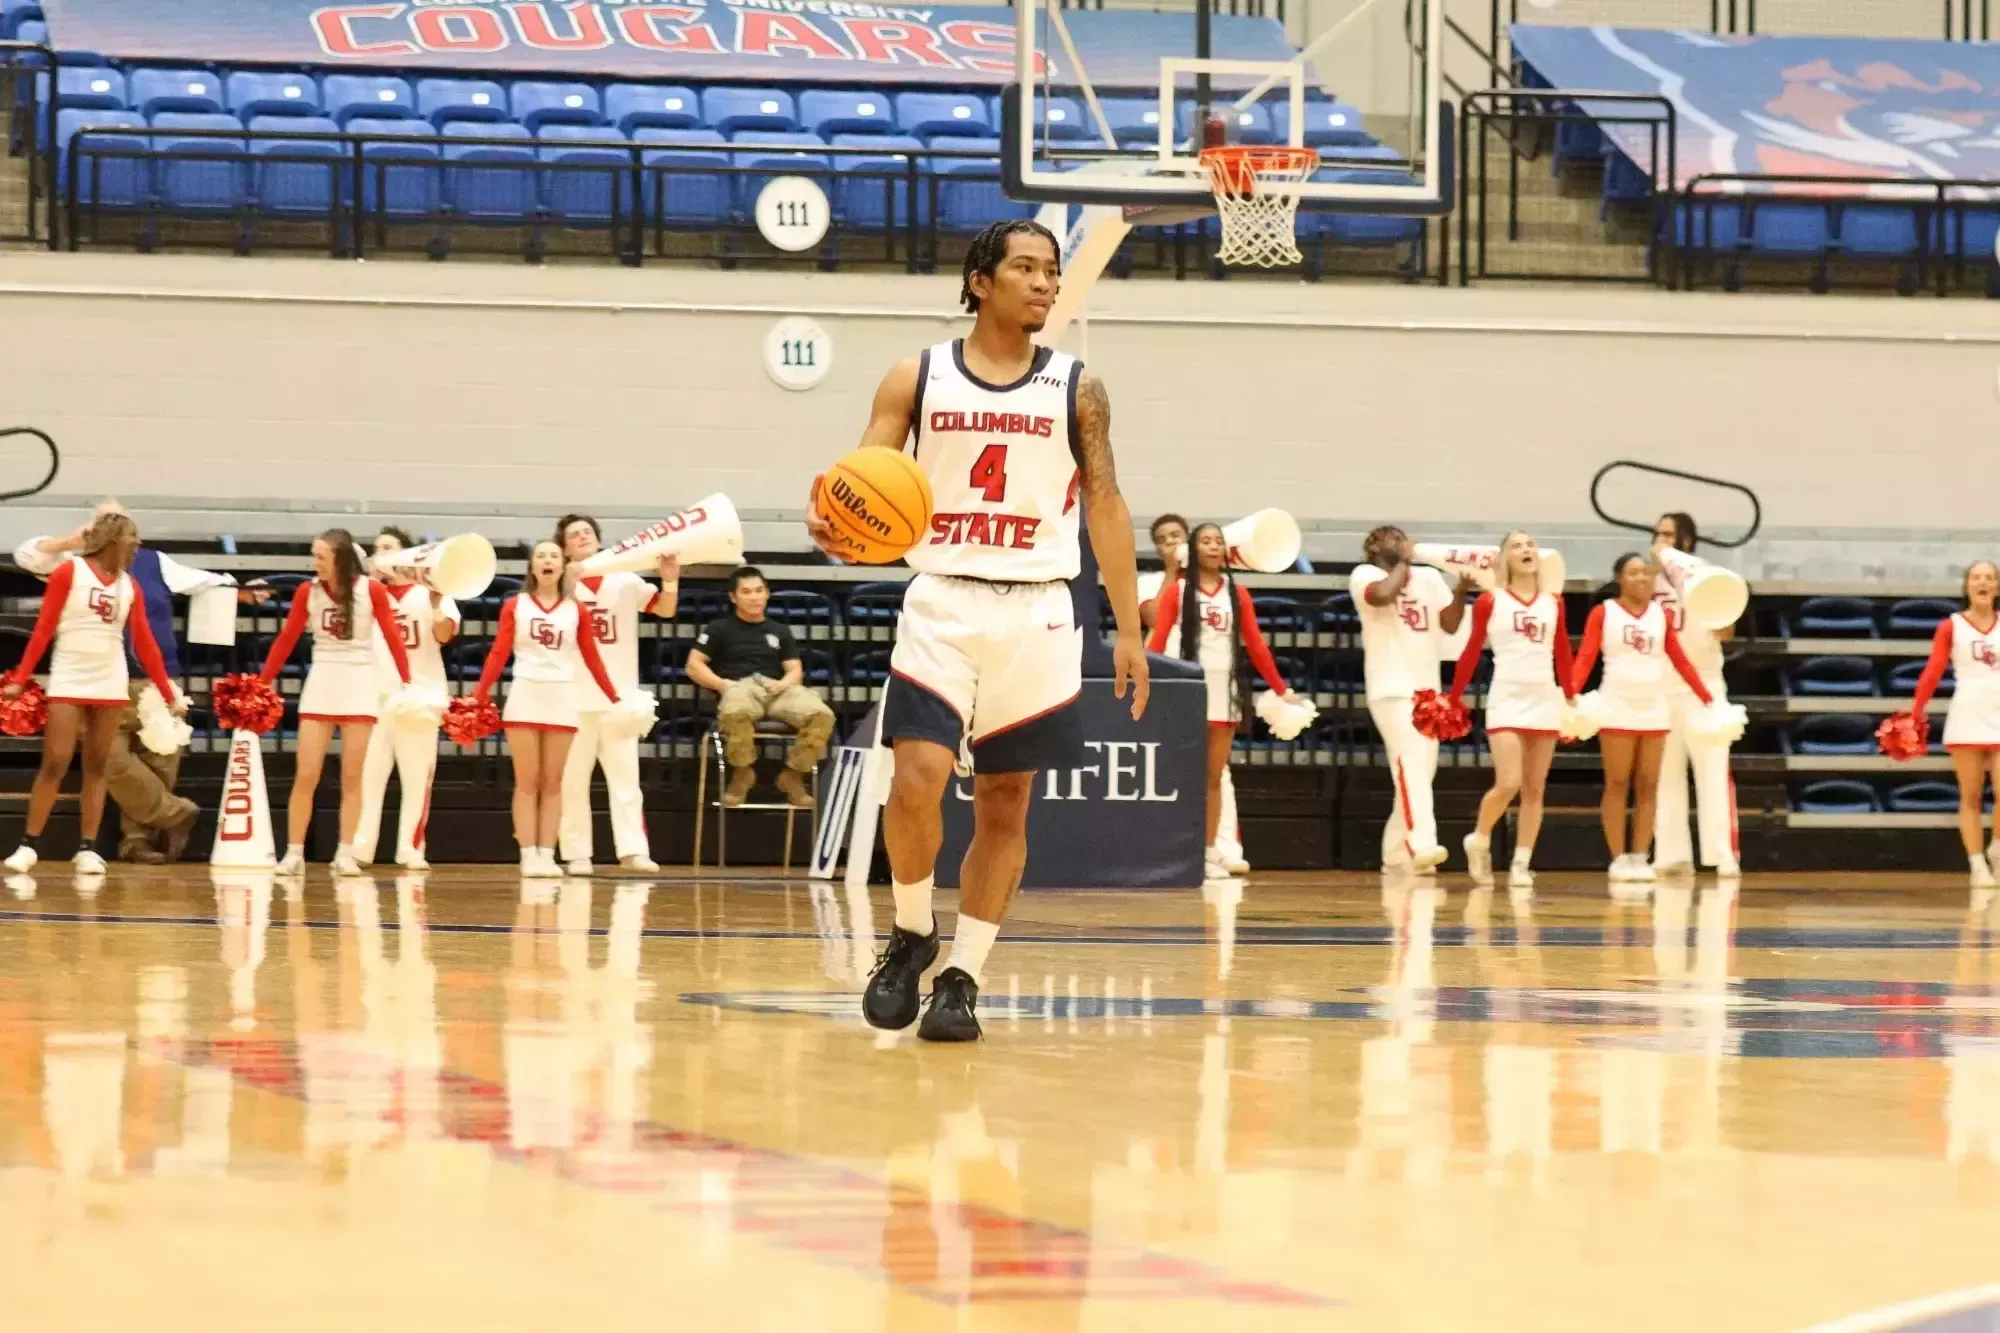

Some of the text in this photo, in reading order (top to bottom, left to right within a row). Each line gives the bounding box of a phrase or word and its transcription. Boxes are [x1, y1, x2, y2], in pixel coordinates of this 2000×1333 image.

[309, 2, 1059, 77] COUGARS
[776, 201, 809, 226] 111
[782, 340, 816, 365] 111
[930, 411, 1054, 438] COLUMBUS
[970, 444, 1008, 503] 4
[831, 475, 892, 537] Wilson
[929, 512, 1042, 550] STATE
[220, 739, 254, 842] COUGARS
[955, 740, 1180, 802] IFEL
